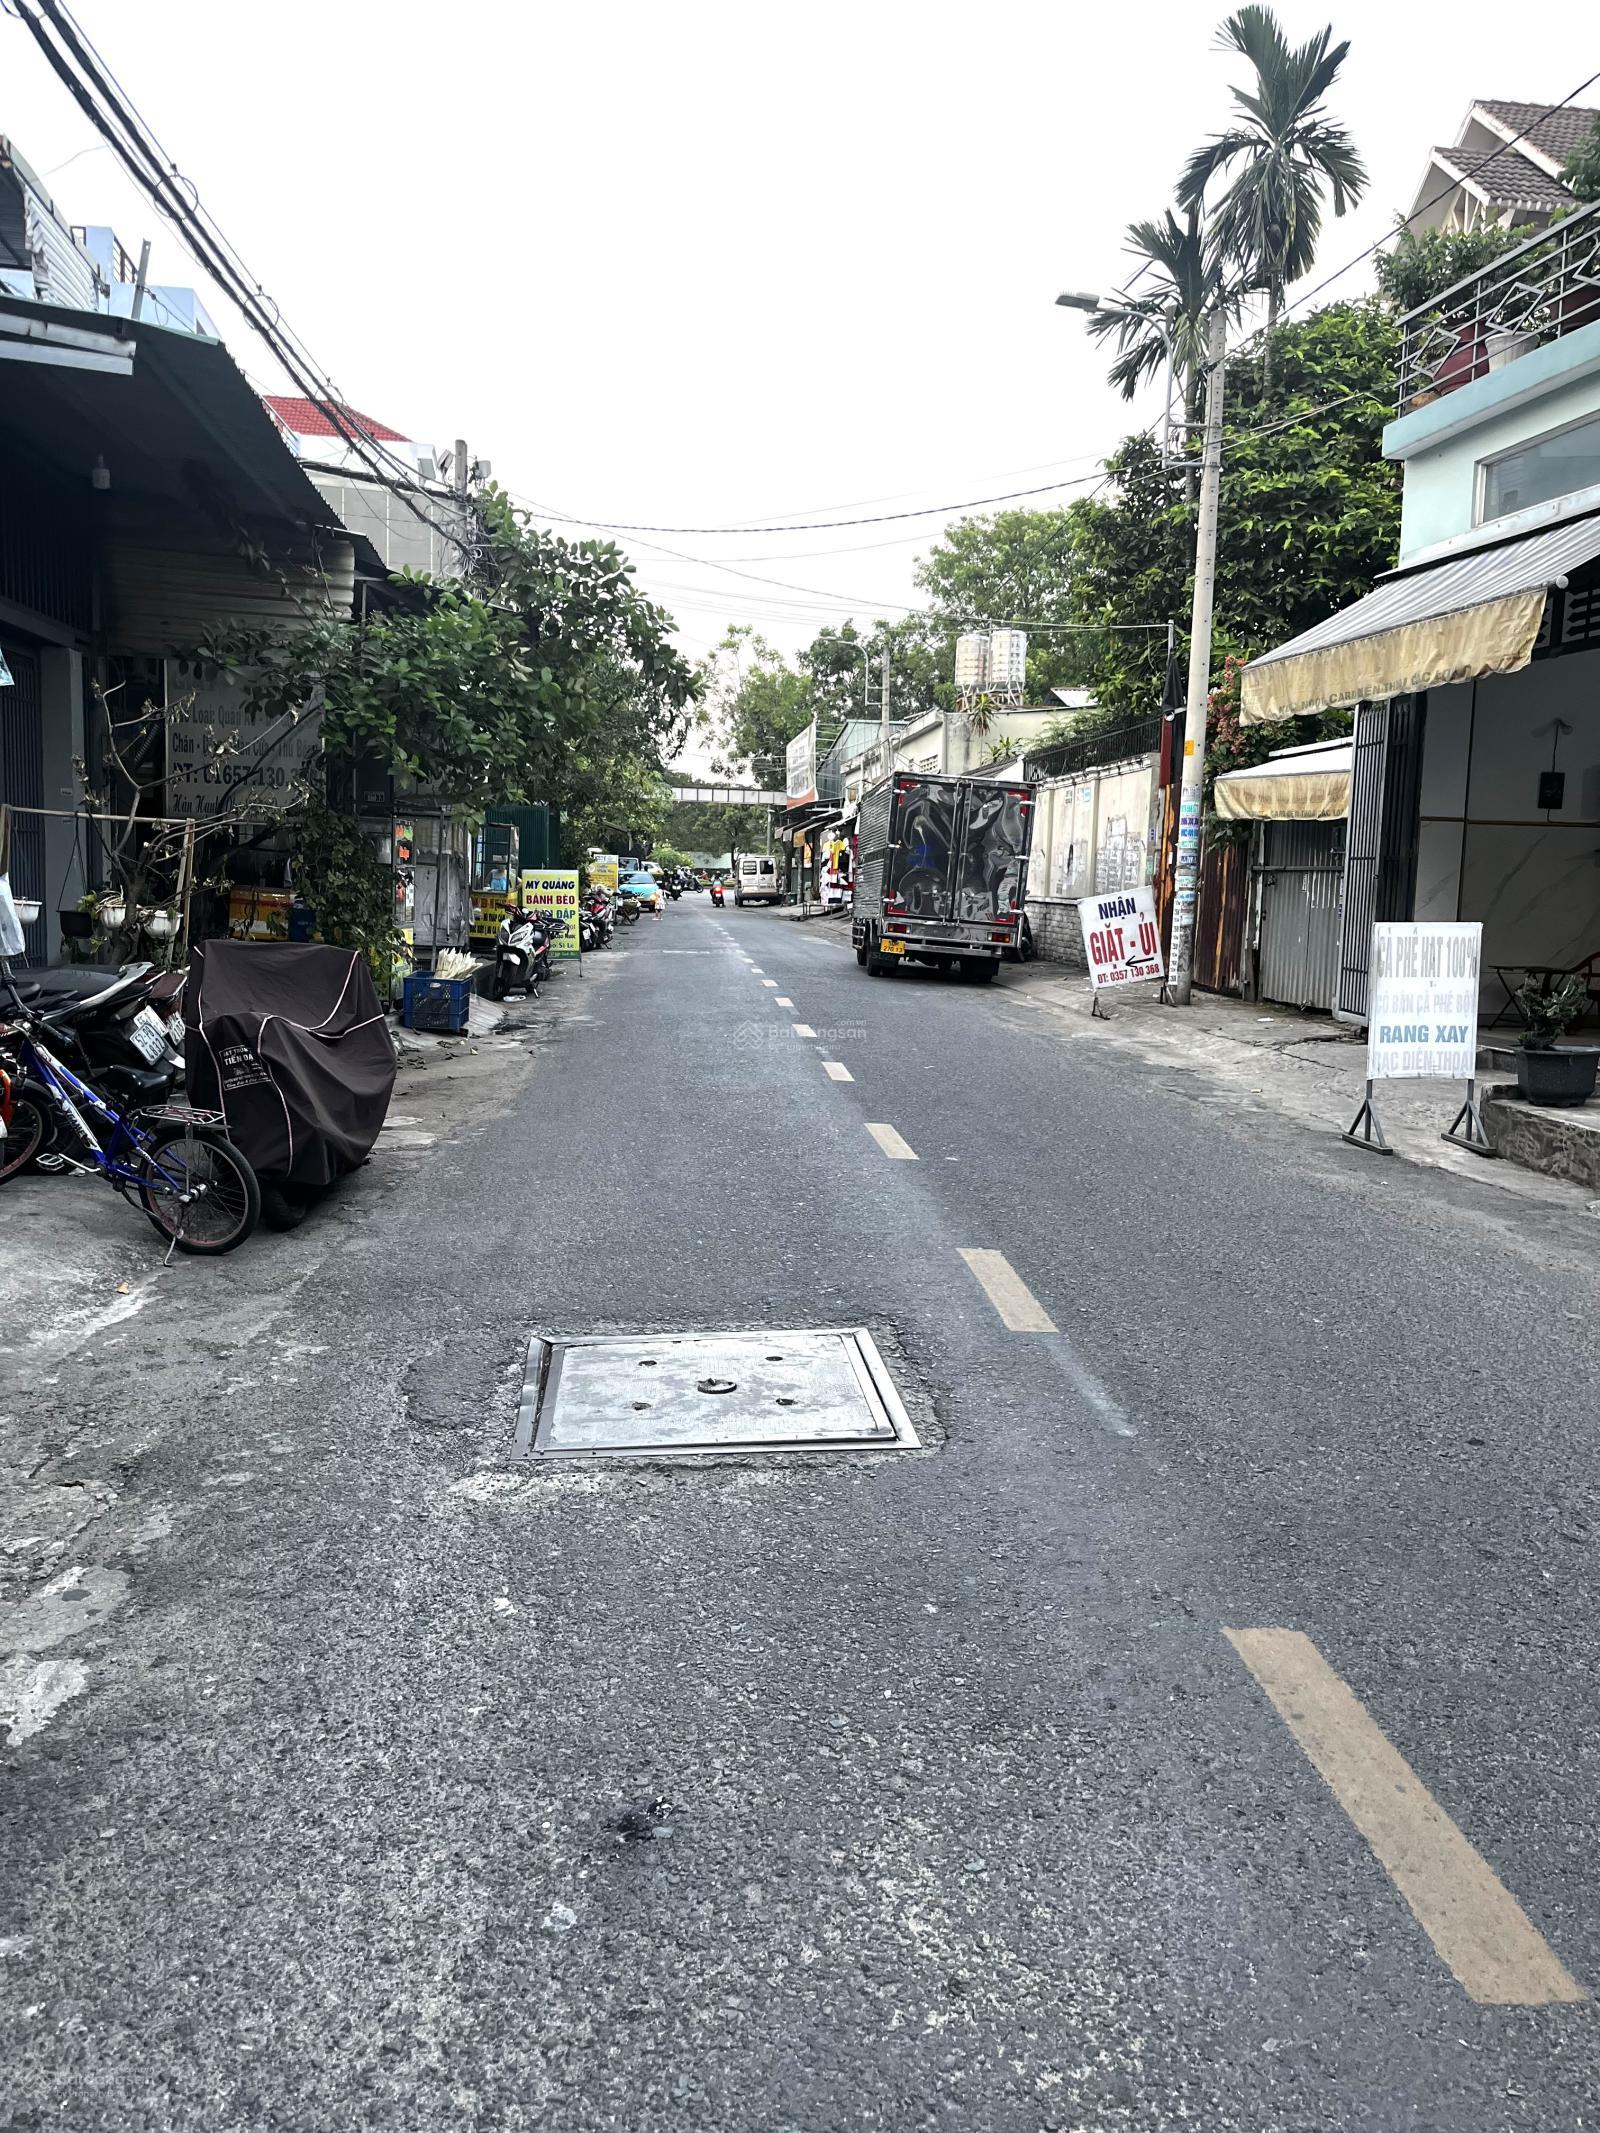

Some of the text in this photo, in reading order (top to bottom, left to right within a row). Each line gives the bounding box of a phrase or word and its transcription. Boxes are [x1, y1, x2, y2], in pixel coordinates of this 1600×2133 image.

[526, 892, 554, 905] BÁNH
[1098, 896, 1137, 920] NHẬN
[1090, 921, 1126, 970] GIẶT
[1138, 911, 1158, 956] ỦI
[1395, 927, 1419, 978] PHÊ
[1445, 935, 1478, 979] 100%
[1110, 969, 1129, 982] 0357
[1130, 966, 1145, 978] 130
[1145, 963, 1160, 976] 368
[1379, 1024, 1470, 1044] RANG XAY
